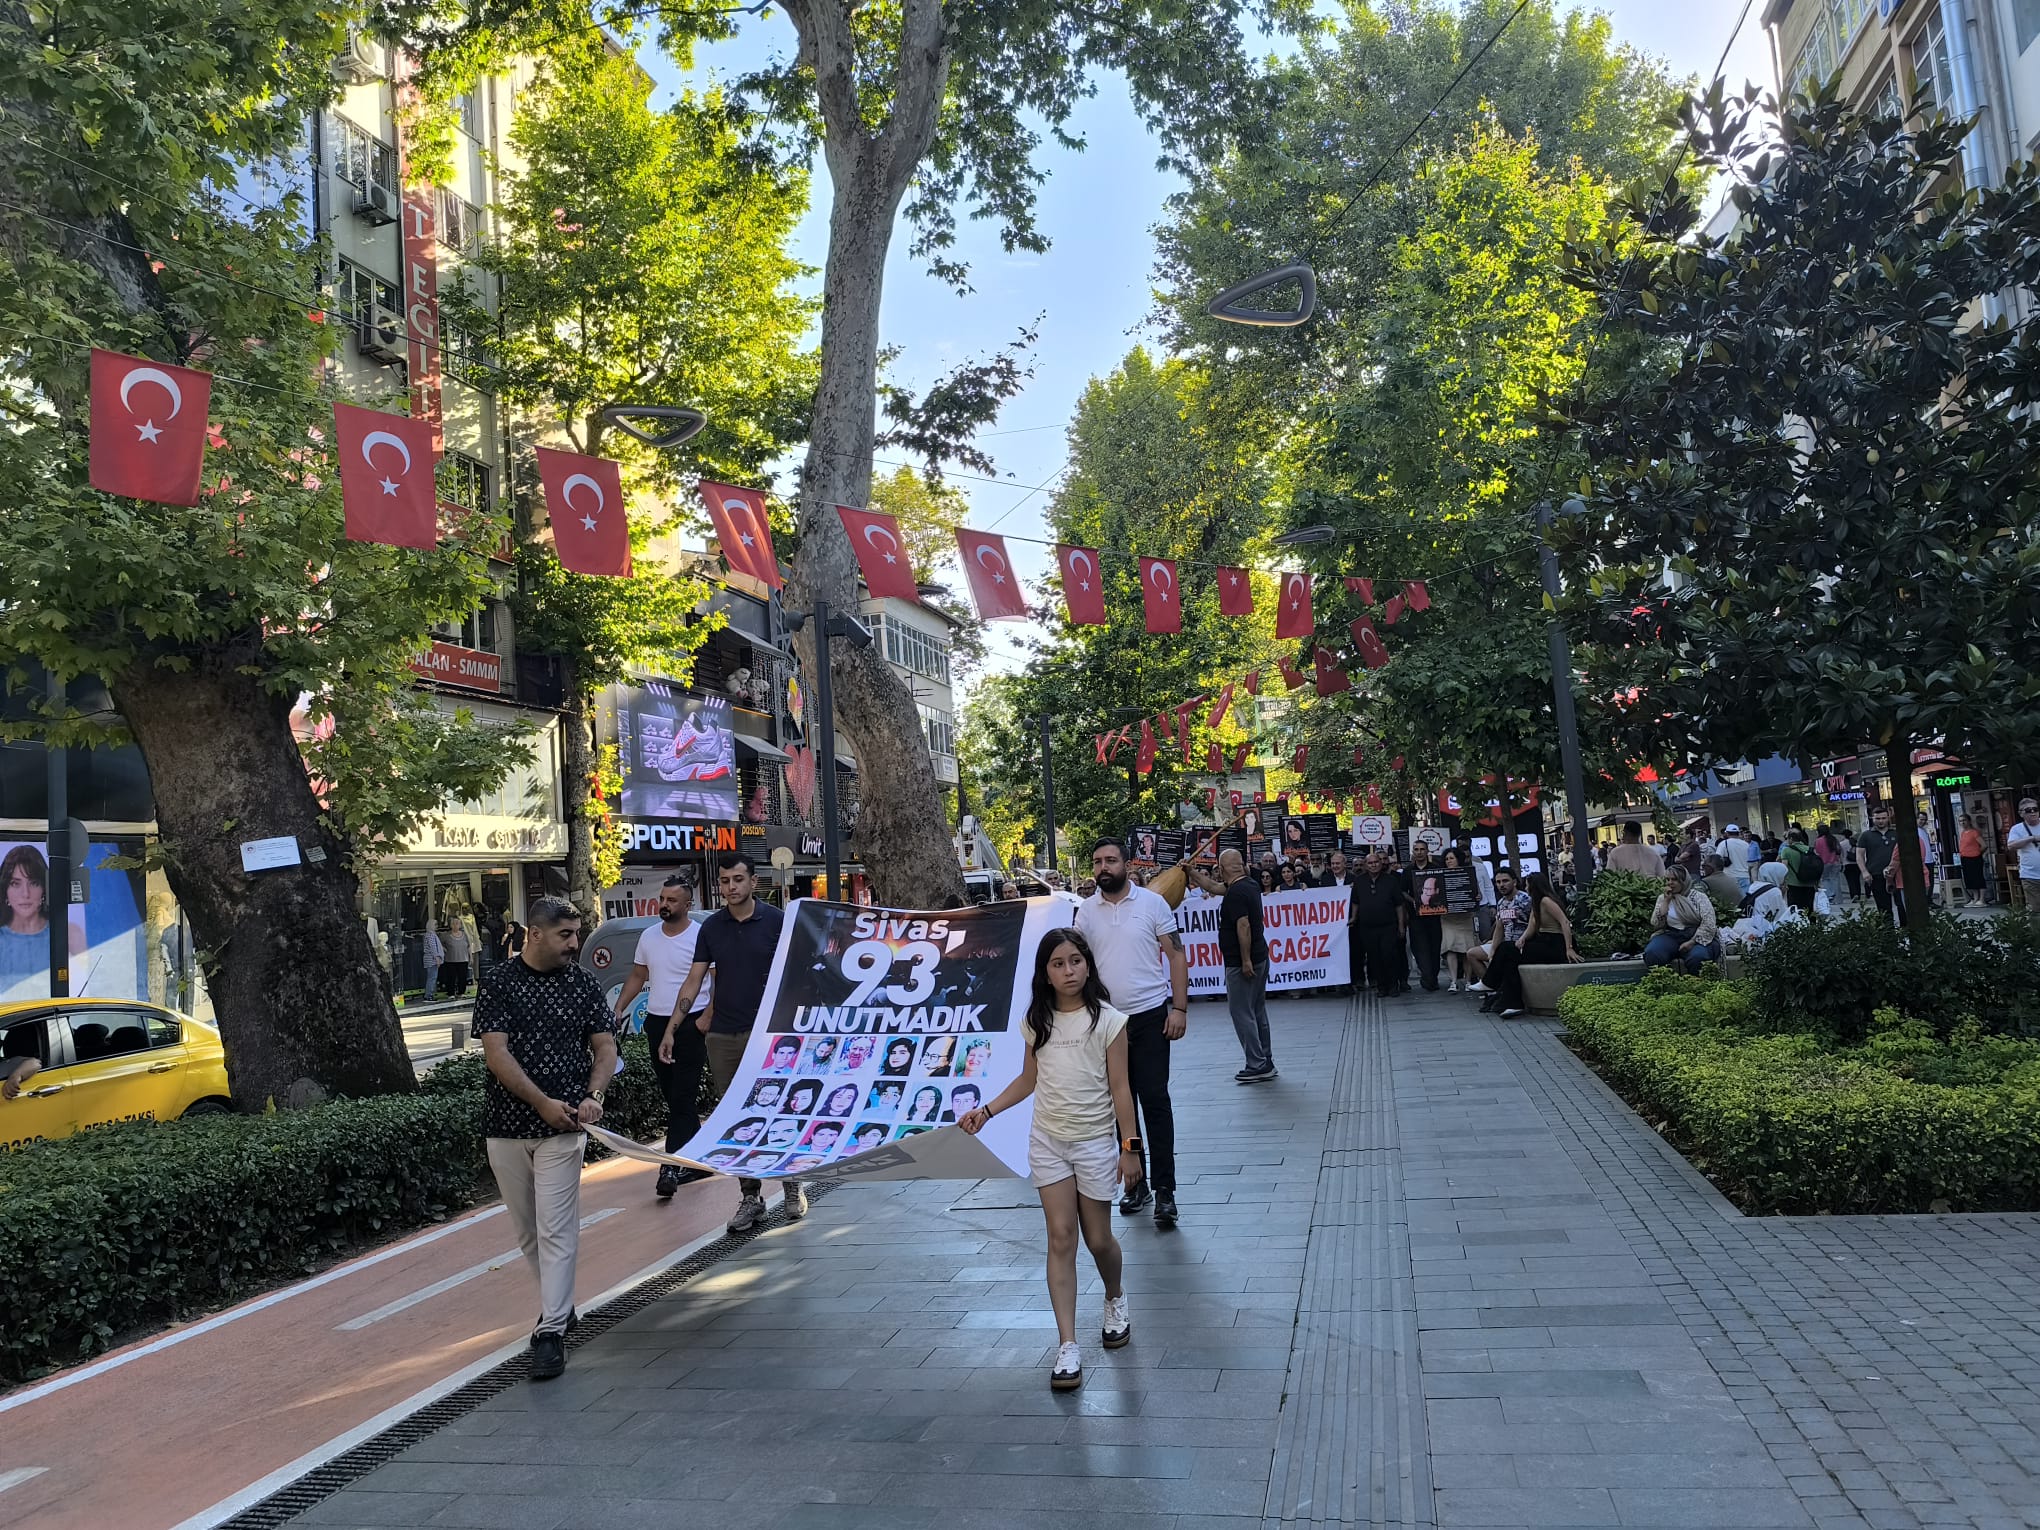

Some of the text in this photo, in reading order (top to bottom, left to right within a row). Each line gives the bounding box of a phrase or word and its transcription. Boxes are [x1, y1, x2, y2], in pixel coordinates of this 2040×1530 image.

[459, 658, 498, 681] SMMM
[1815, 779, 1824, 793] AK
[1830, 793, 1841, 801] AK
[441, 827, 480, 847] KAYA
[620, 823, 737, 850] SPORTRUN
[741, 824, 766, 837] pastane
[802, 832, 822, 857] Ümit
[840, 940, 941, 1007] 93
[1266, 968, 1326, 984] LATFORMU
[793, 1003, 989, 1034] UNUTMADIK
